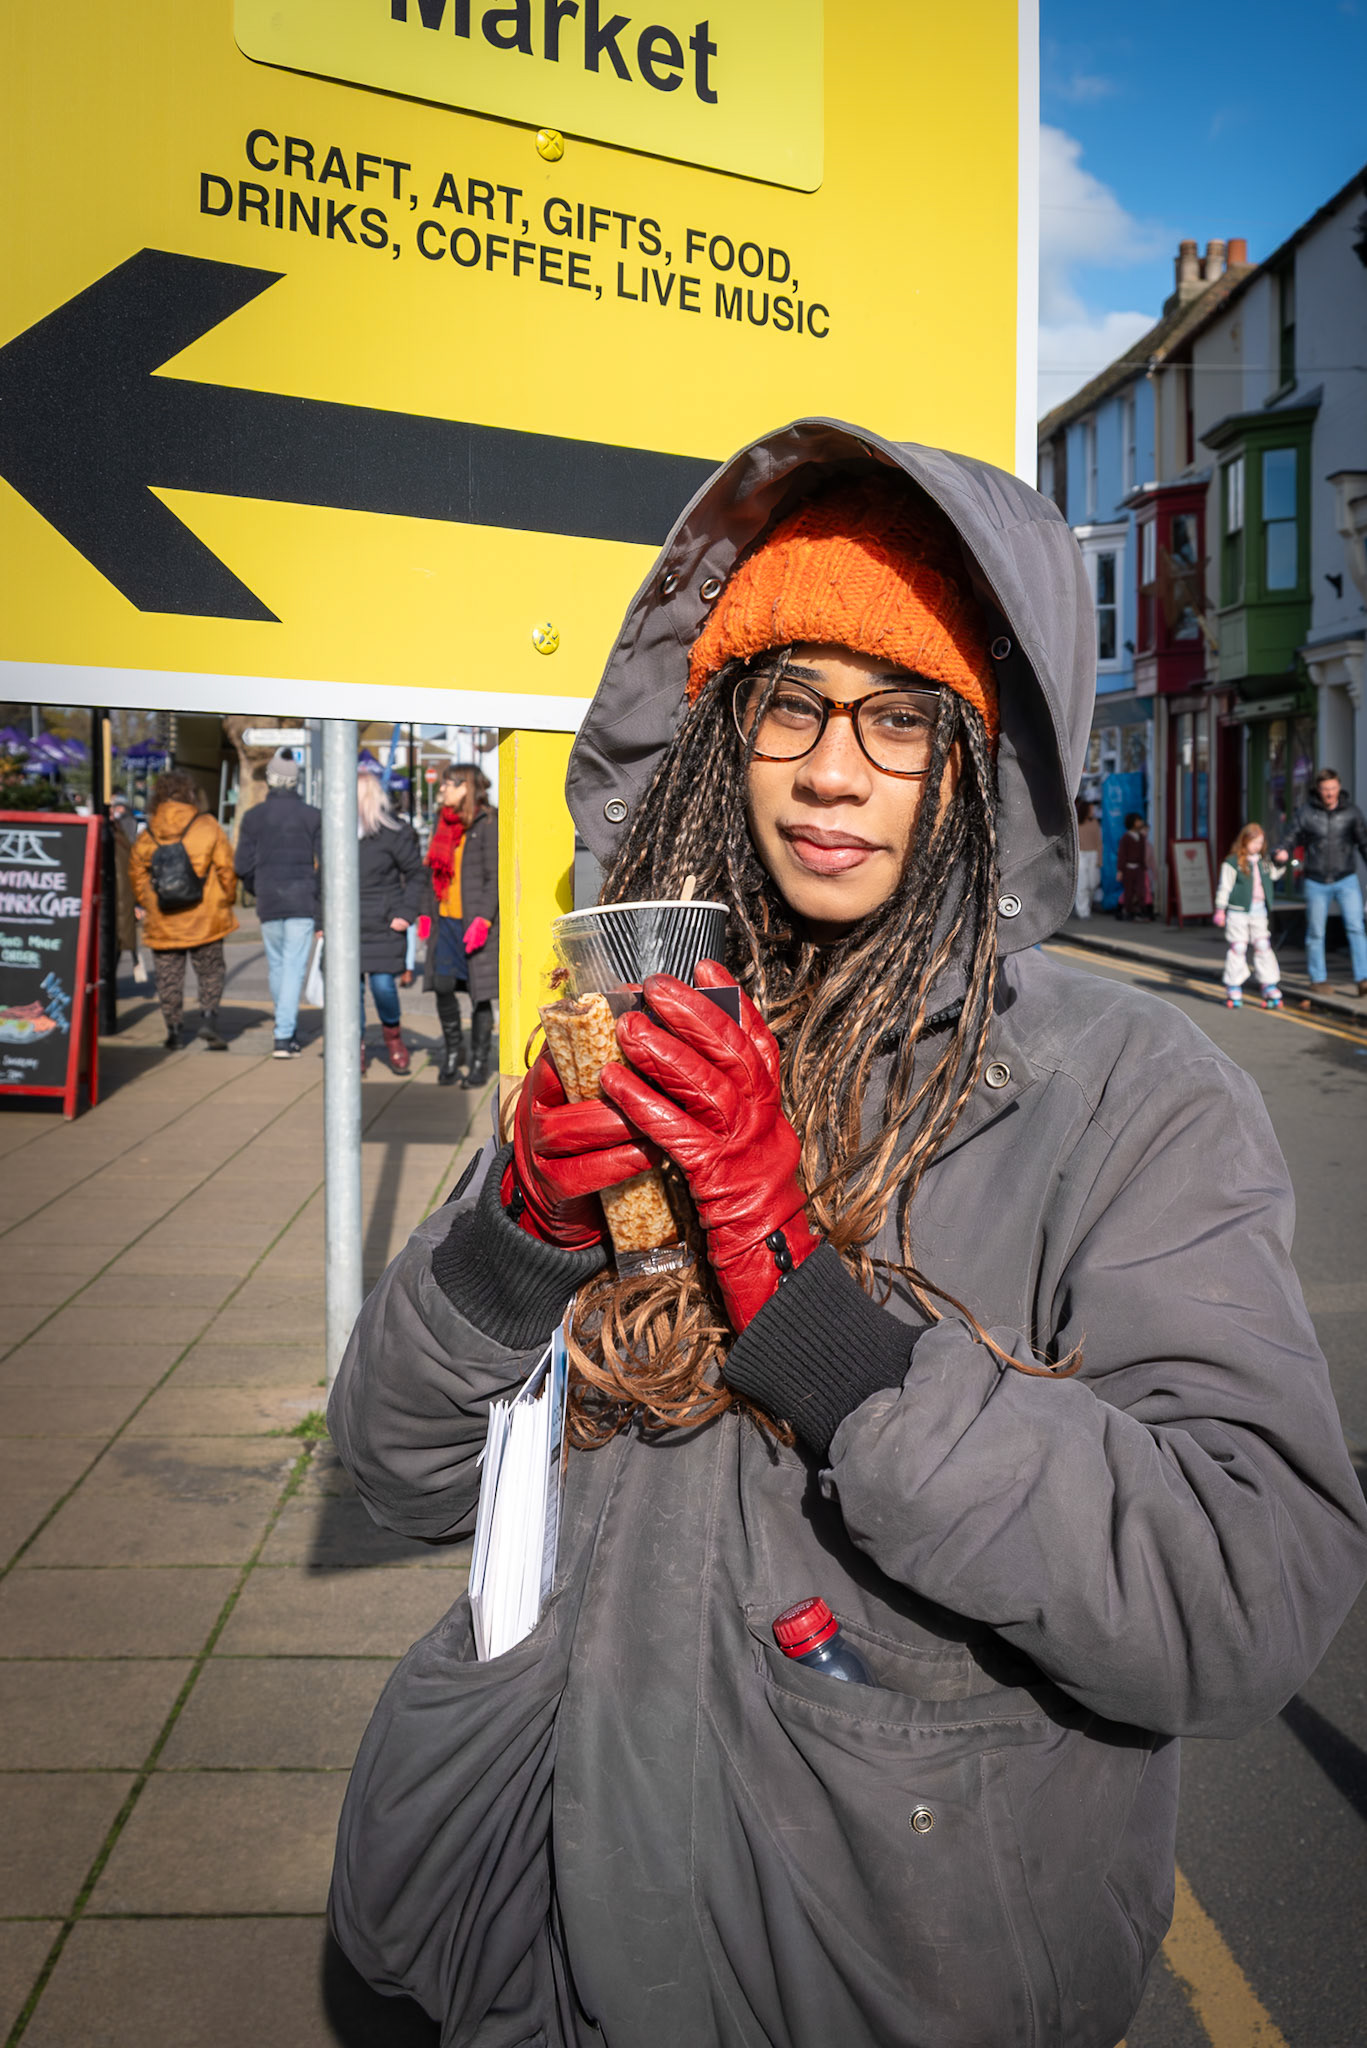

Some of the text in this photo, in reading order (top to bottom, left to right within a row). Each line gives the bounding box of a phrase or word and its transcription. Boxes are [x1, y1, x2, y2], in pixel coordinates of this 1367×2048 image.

[200, 172, 830, 338] DRINKS, COFFEE, LIVE MUSIC
[246, 128, 798, 293] CRAFT, ART, GIFTS, FOOD,
